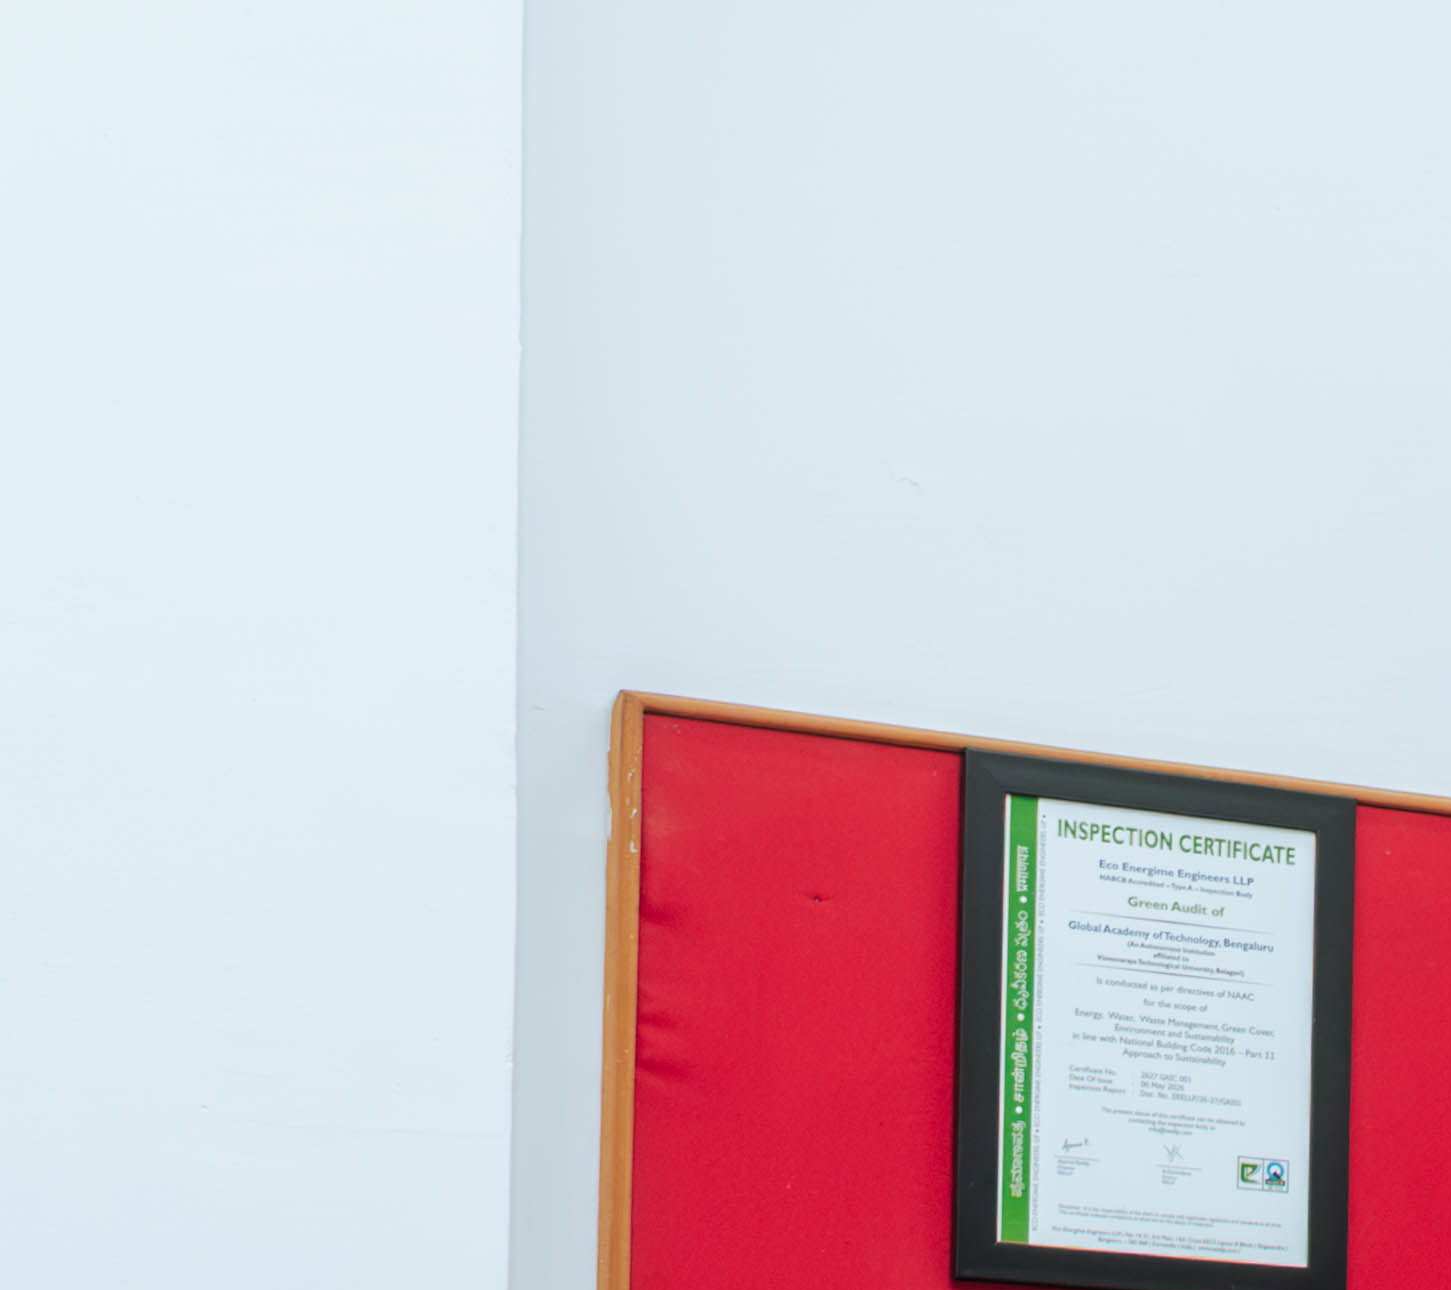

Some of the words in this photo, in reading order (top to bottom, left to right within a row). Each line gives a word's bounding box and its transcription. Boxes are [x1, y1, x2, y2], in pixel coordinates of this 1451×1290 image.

[1057, 818, 1173, 851] INSPECTION
[1179, 833, 1297, 866] CERTIFICATE
[1099, 859, 1120, 871] Eco
[1122, 861, 1174, 879] Energime
[1177, 868, 1230, 885] Engineers
[1232, 876, 1255, 887] LLP
[1128, 896, 1168, 912] Green
[1171, 901, 1206, 917] Audit
[1211, 907, 1225, 918] of
[1068, 920, 1101, 933] Global
[1104, 925, 1150, 940] Academy
[1153, 930, 1164, 939] of
[1223, 938, 1274, 953] Bengaluru
[1160, 983, 1174, 994] per
[1177, 984, 1215, 997] directives
[1217, 990, 1226, 999] of
[1227, 991, 1255, 1002] NAAC
[1143, 998, 1155, 1007] for
[1158, 1000, 1172, 1009] the
[1173, 1003, 1198, 1013] scope
[1199, 1003, 1208, 1013] of
[1114, 1023, 1166, 1037] Environment
[1167, 1029, 1182, 1039] and
[1099, 1034, 1118, 1045] with
[1119, 1036, 1154, 1048] National
[1156, 1039, 1188, 1052] Building
[1189, 1042, 1212, 1053] Code
[1121, 1048, 1162, 1060] Approach
